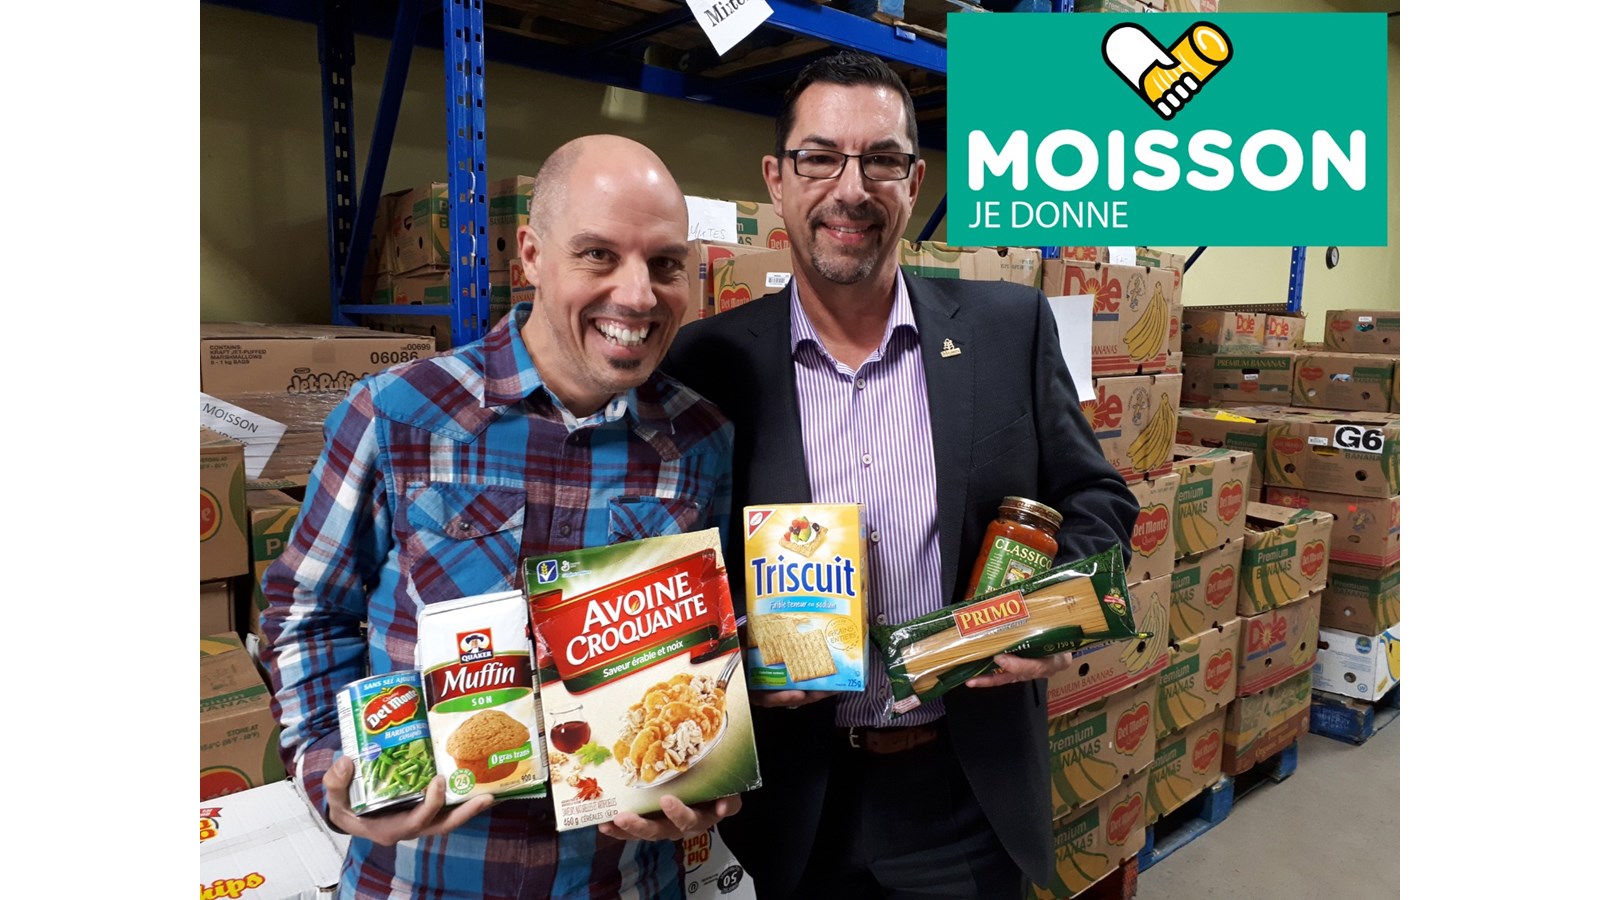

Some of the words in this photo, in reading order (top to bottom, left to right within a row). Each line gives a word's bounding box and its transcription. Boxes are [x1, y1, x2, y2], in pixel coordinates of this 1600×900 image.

[1236, 314, 1255, 332] Dole
[1269, 317, 1289, 336] Dole
[370, 351, 419, 364] 06086
[1217, 359, 1249, 367] PREMIUM
[1250, 359, 1286, 368] BANANAS
[203, 403, 259, 433] MOISSON
[1335, 426, 1383, 451] G6
[1133, 523, 1145, 537] Del
[1146, 518, 1168, 534] Monte
[995, 538, 1053, 570] CLASSICO
[751, 554, 856, 597] Triscuit
[582, 571, 693, 635] AVOINE
[959, 599, 1021, 631] PRIMO
[565, 593, 708, 666] CROQUANTE
[1247, 610, 1288, 653] Dole
[461, 651, 493, 662] QUAKER
[602, 660, 631, 678] Saveur
[631, 651, 657, 668] érable
[656, 647, 666, 659] et
[666, 641, 684, 655] noix
[363, 680, 382, 690] SANS
[441, 663, 516, 697] Muffin
[1082, 667, 1115, 686] BANANAS
[367, 704, 393, 728] Del
[389, 690, 417, 710] Monte
[471, 695, 493, 706] SON
[1118, 725, 1128, 737] Del
[491, 753, 498, 764] 0
[498, 752, 513, 764] gras
[456, 776, 469, 787] 24
[723, 871, 738, 887] 50
